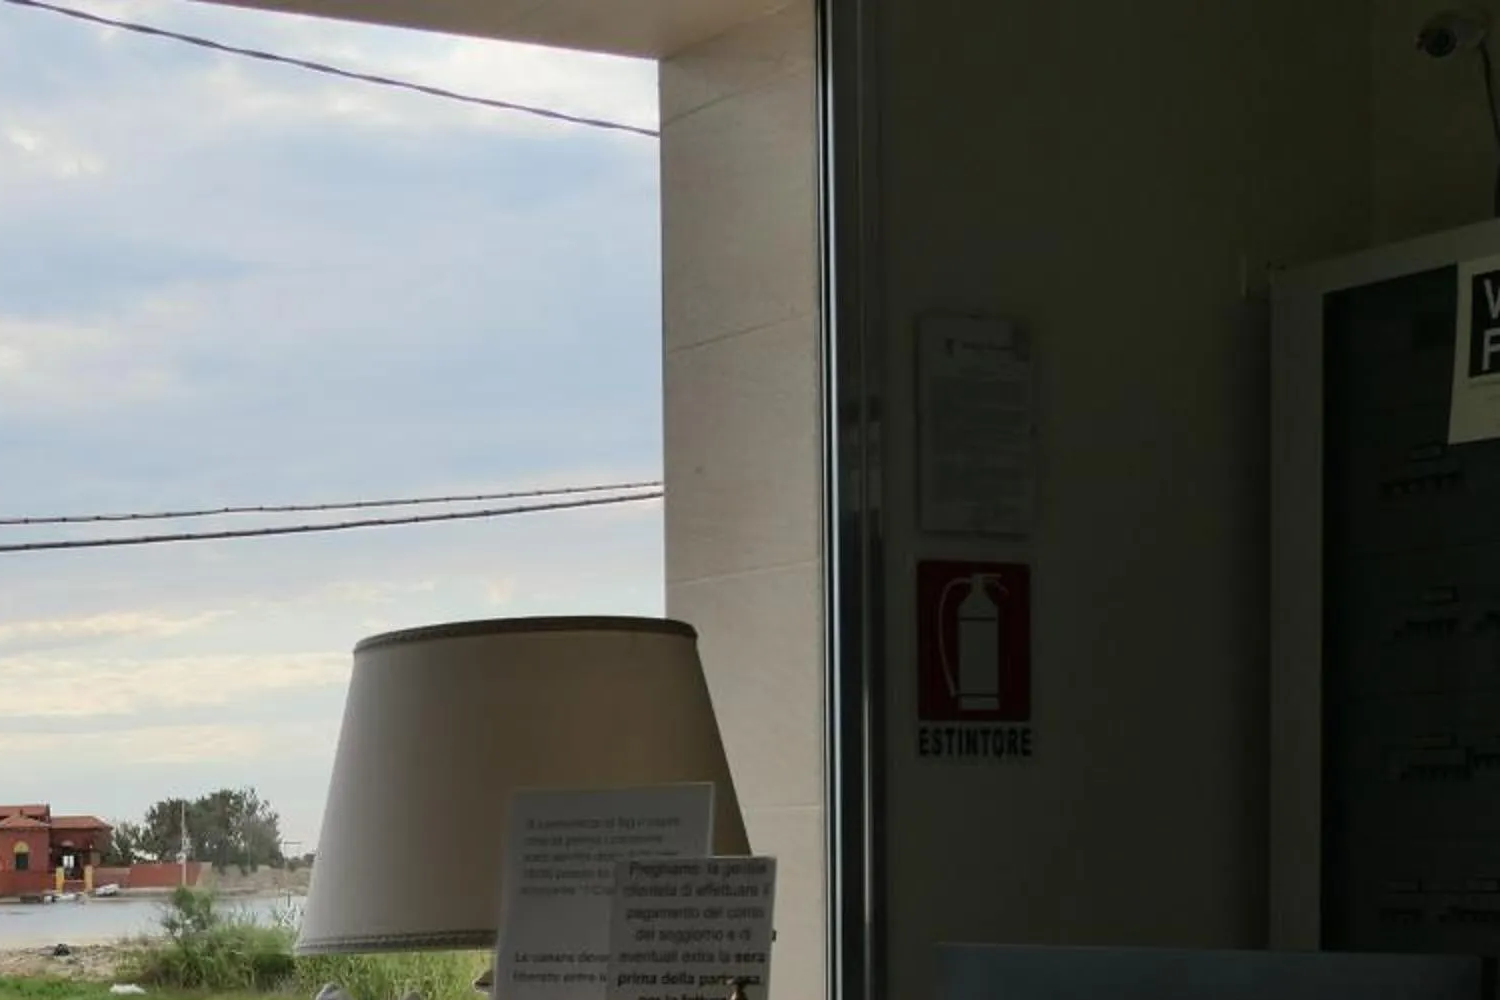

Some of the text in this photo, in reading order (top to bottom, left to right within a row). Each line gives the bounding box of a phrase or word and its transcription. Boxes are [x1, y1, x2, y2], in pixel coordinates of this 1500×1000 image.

[918, 726, 1033, 759] ESTINTORE
[617, 971, 657, 987] prima
[660, 970, 695, 985] della
